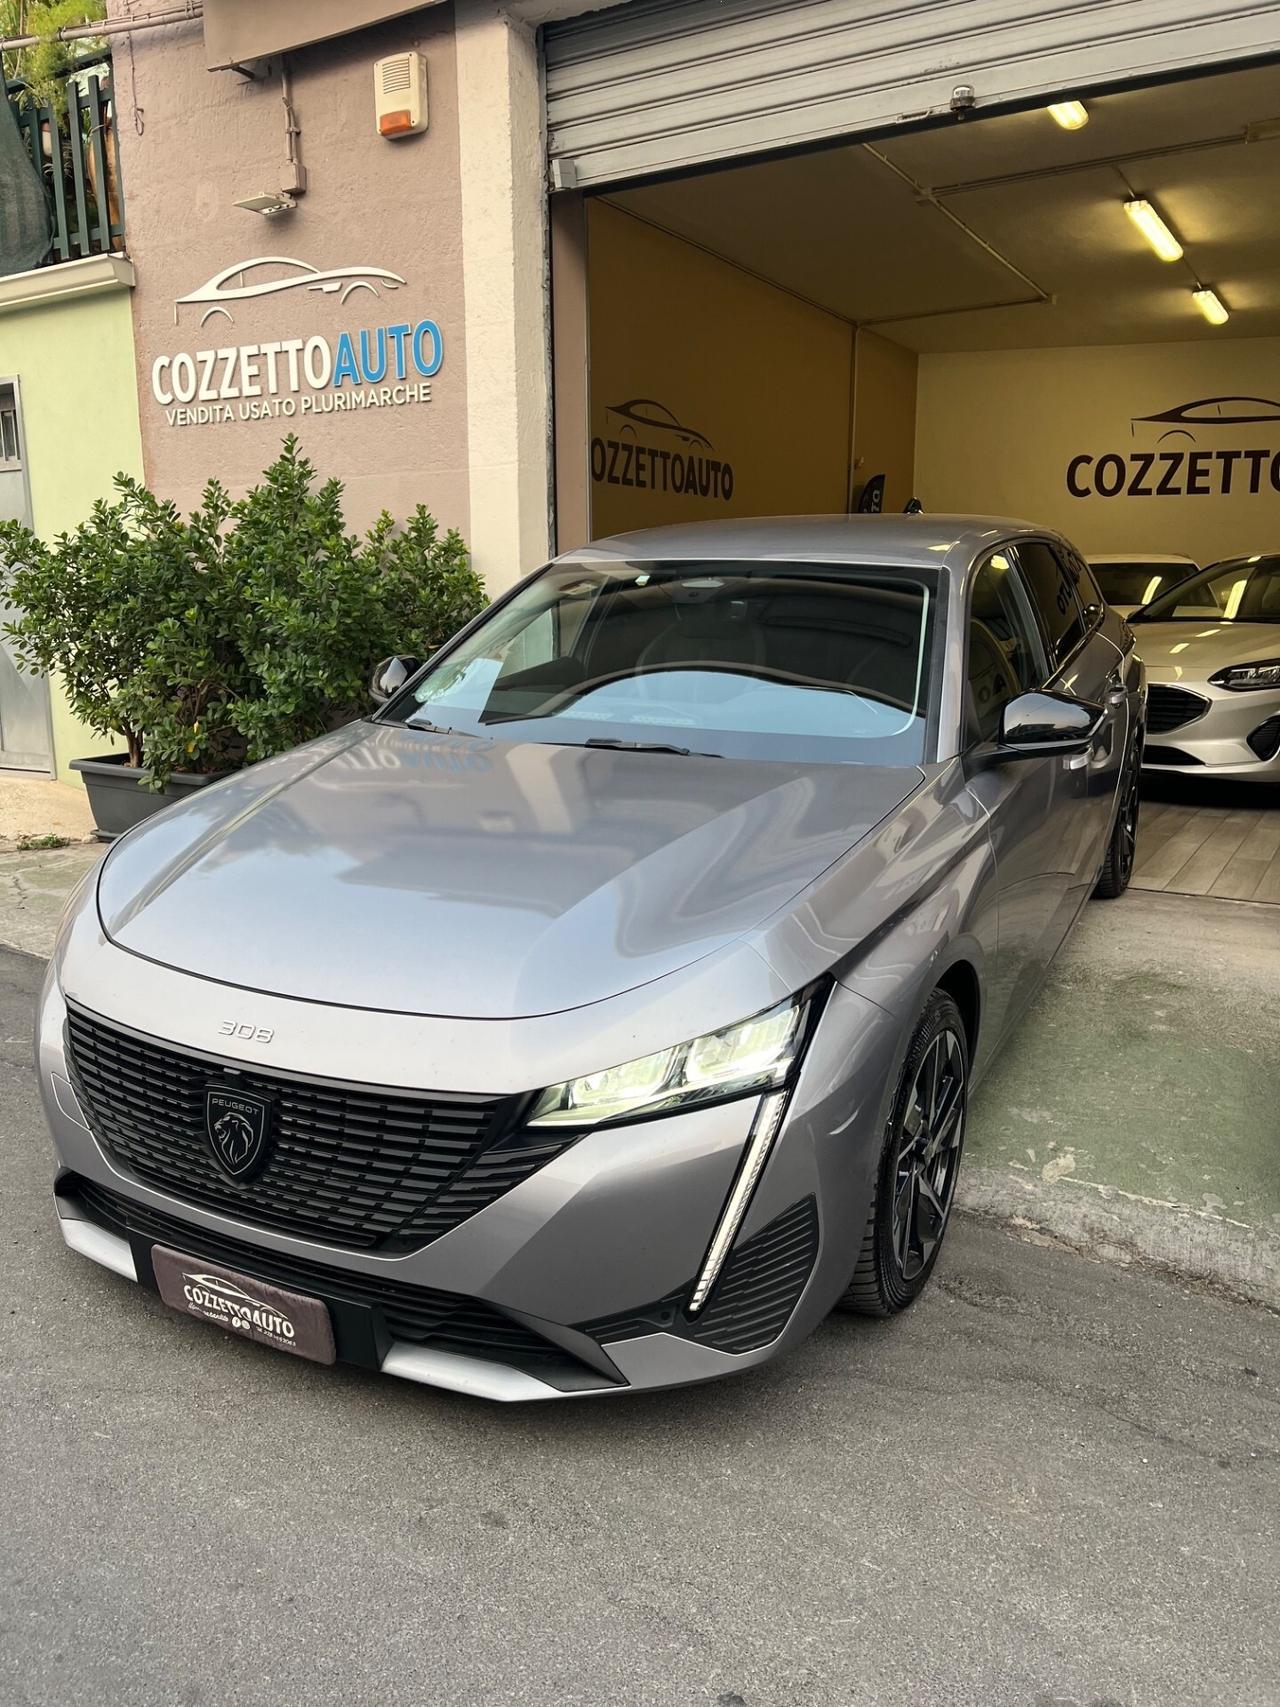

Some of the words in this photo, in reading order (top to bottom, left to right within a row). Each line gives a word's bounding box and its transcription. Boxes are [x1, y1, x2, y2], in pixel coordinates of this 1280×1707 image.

[166, 405, 236, 426] VENDITA
[239, 398, 296, 420] USATO
[301, 382, 432, 414] PLURIMARCHE
[590, 437, 734, 501] OZZETTOAUTO
[218, 1019, 275, 1043] 308
[211, 1097, 260, 1115] PEUGEOT
[184, 1285, 295, 1338] COZZETTOAUTO
